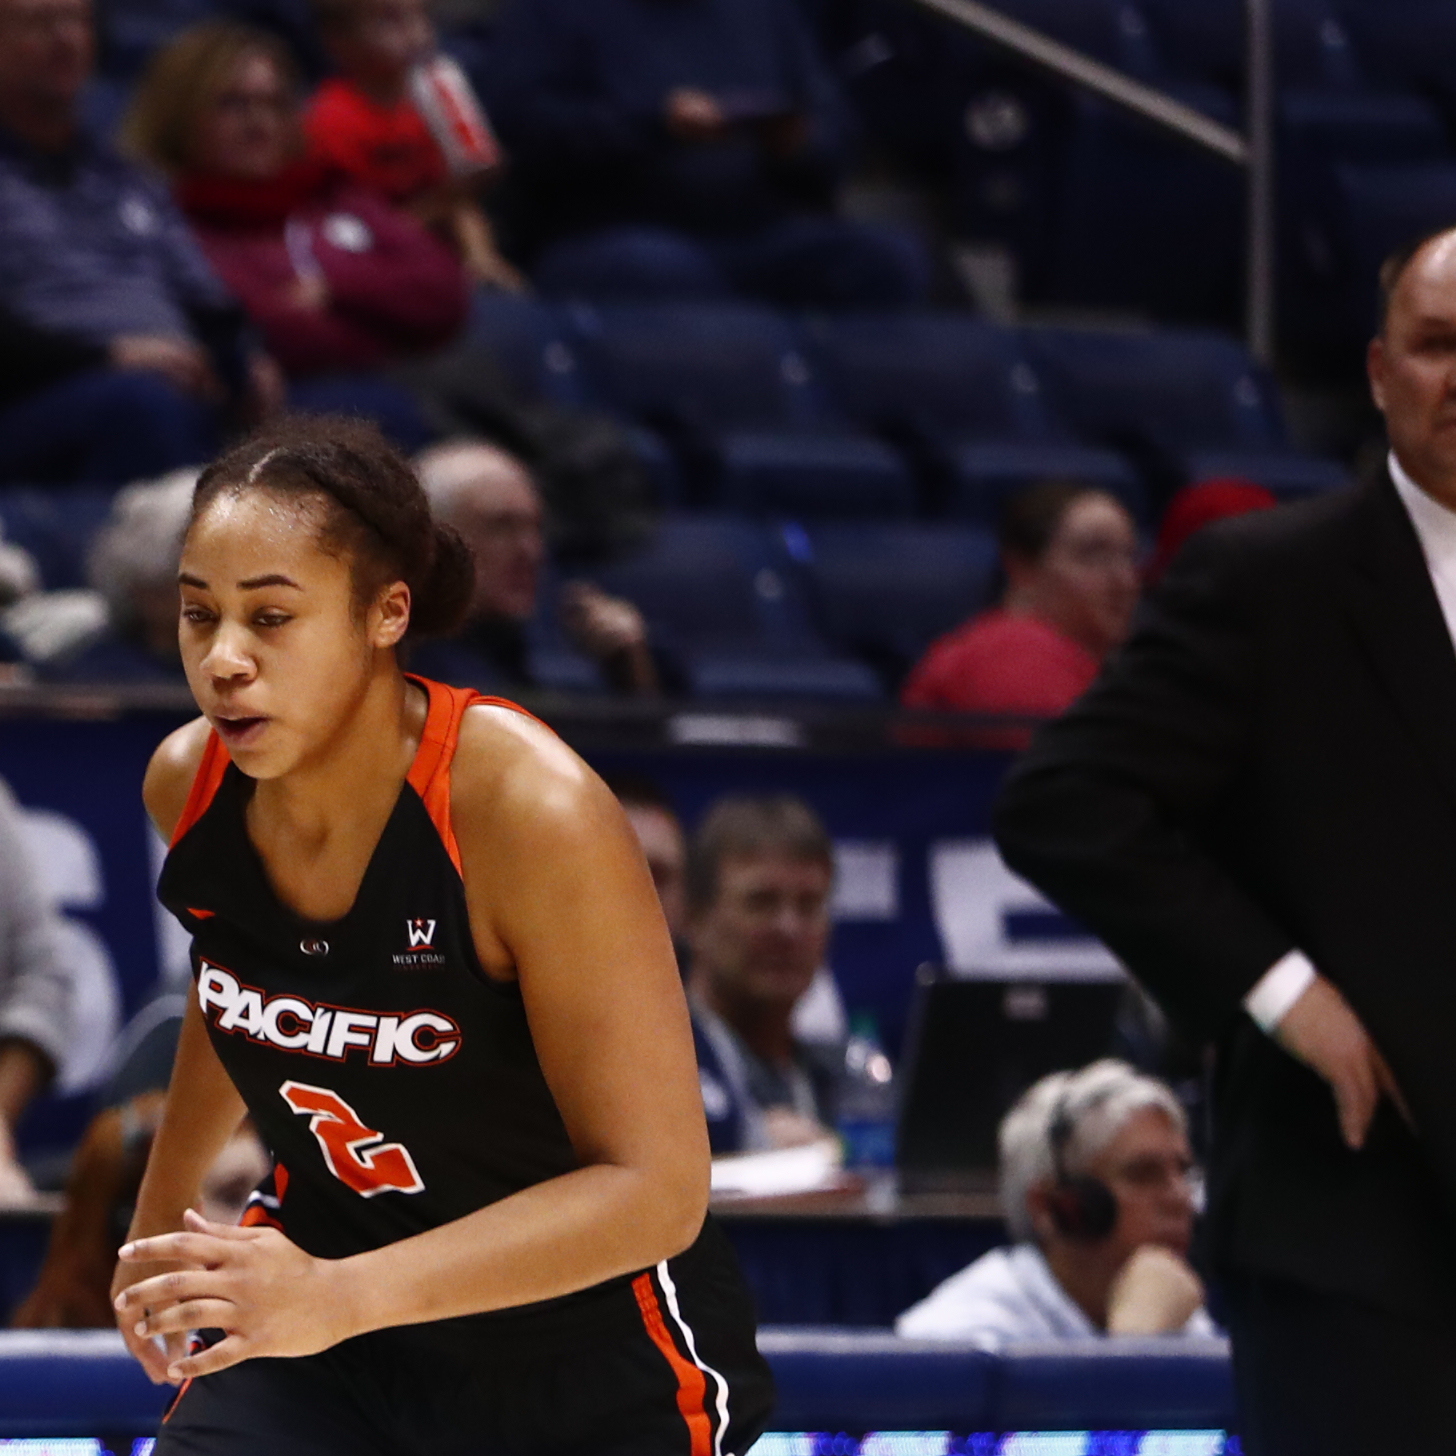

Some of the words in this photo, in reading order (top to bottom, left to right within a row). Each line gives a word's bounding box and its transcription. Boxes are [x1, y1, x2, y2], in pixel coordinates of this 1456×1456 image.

[197, 956, 462, 1067] PACIFIC
[392, 954, 418, 964] WEST
[278, 1079, 426, 1199] 2
